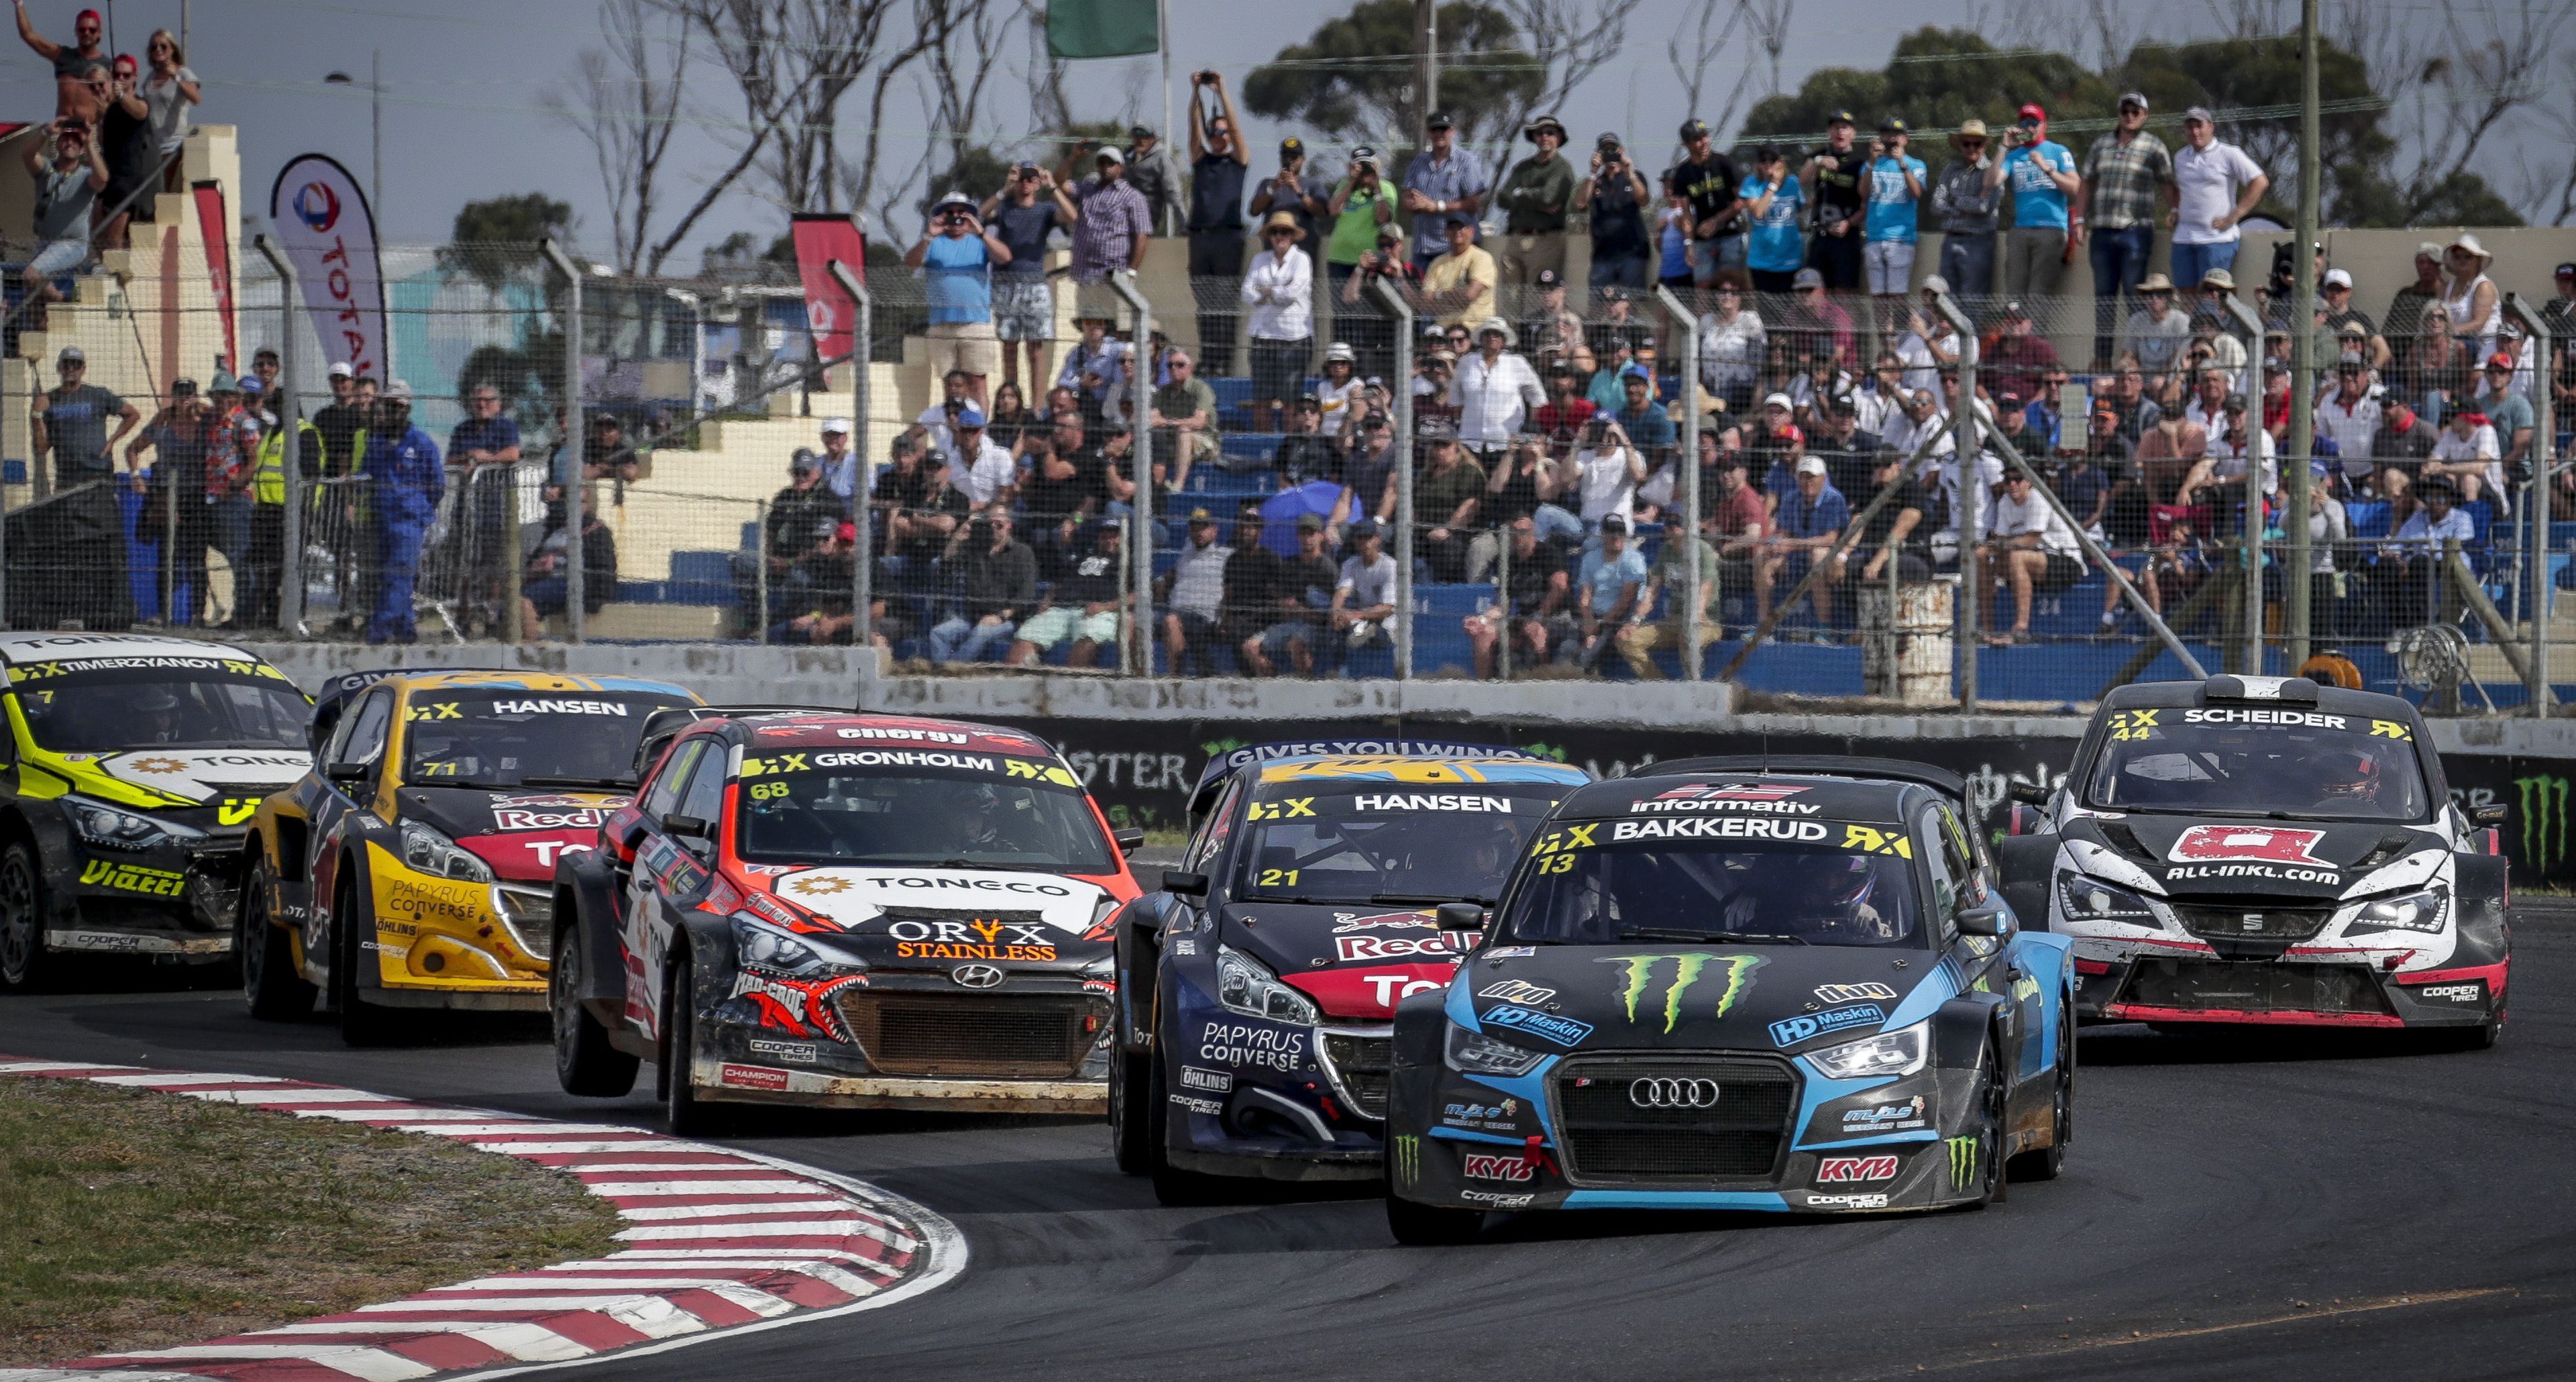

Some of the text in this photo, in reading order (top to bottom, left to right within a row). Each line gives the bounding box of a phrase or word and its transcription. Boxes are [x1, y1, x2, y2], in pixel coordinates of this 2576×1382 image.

[60, 657, 219, 672] TIMERZYANOV
[38, 690, 54, 704] 7
[493, 699, 628, 717] HANSEN
[2184, 709, 2347, 730] SCHEIDER
[836, 727, 970, 744] energy
[2112, 727, 2150, 741] 44
[423, 762, 456, 777] 71
[814, 751, 994, 773] GRONHOLM
[1055, 741, 1193, 795] STER
[750, 782, 790, 801] 68
[1354, 795, 1513, 813] HANSEN
[1630, 797, 1822, 815] informativ
[493, 808, 602, 830] Red
[1613, 817, 1828, 842] BAKKERUD
[1538, 853, 1576, 875] 13
[1259, 869, 1300, 887] 21
[392, 880, 480, 906] PAPYRUS
[376, 918, 417, 937] ÖHLINS
[889, 918, 1055, 947] ORYX
[896, 941, 1057, 962] STAINLESS
[2422, 986, 2479, 997] COOPER
[2451, 994, 2478, 1002] TIRES
[1485, 1006, 1529, 1024] HD
[1524, 1014, 1583, 1039] Maskin
[1775, 1018, 1817, 1043] HD
[1817, 1007, 1878, 1025] Maskin
[1203, 1022, 1304, 1054] PAPYRUS
[751, 1041, 815, 1055] COOPER
[781, 1052, 814, 1061] TIRES
[724, 1068, 786, 1083] CHAMPION
[1183, 1067, 1229, 1089] ÖHLINS
[1169, 1094, 1224, 1109] COOPER
[1189, 1105, 1222, 1115] TIRES
[1464, 1153, 1534, 1181] KYB
[1817, 1155, 1898, 1183] KYB
[1807, 1193, 1888, 1205] COOPER
